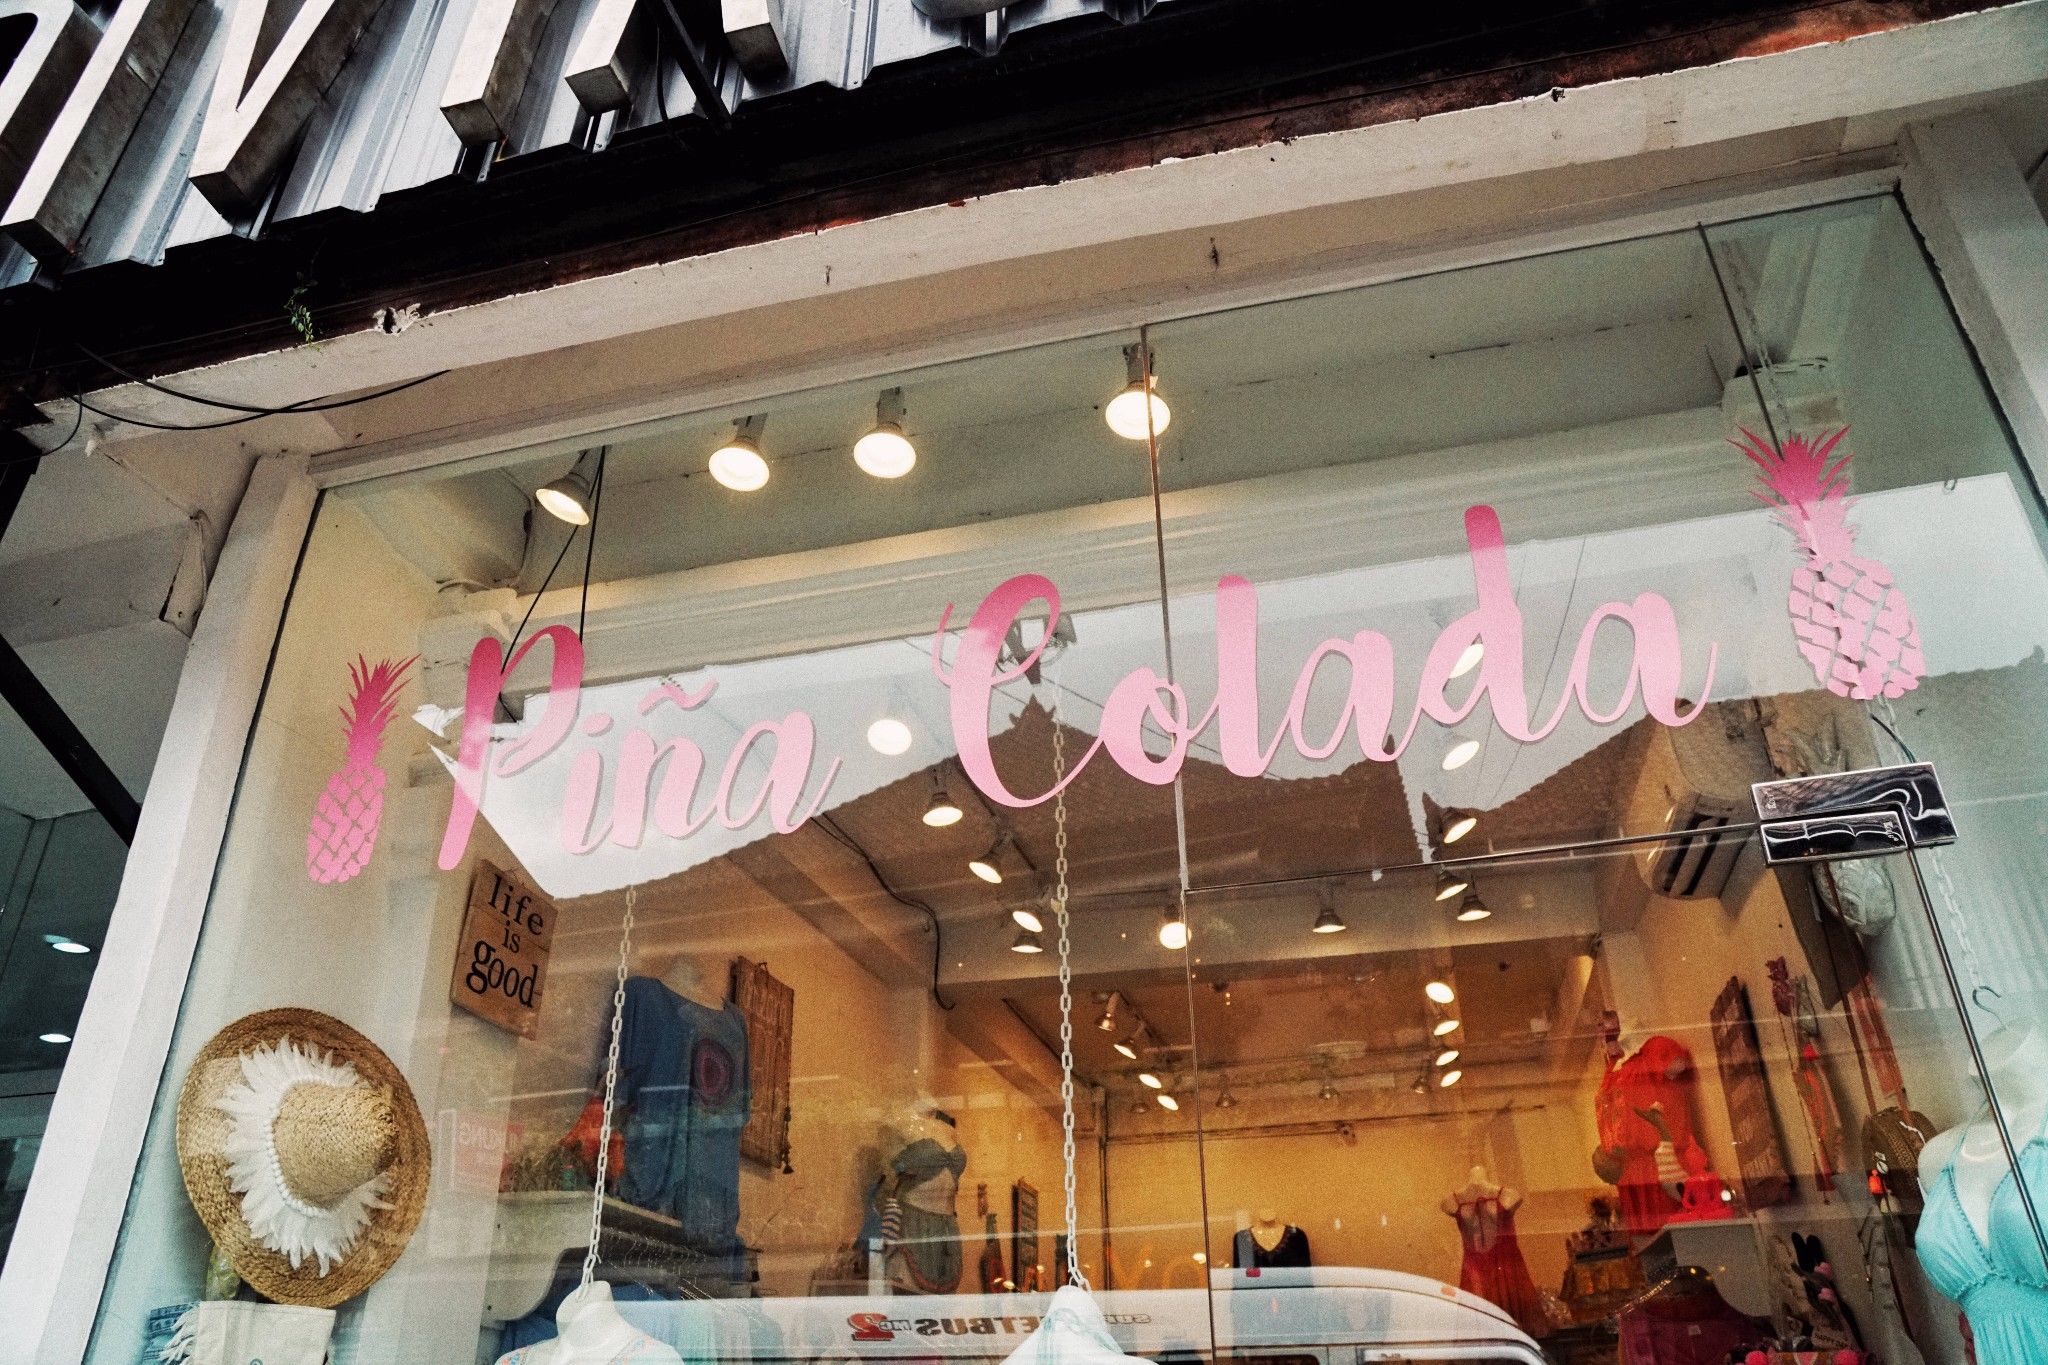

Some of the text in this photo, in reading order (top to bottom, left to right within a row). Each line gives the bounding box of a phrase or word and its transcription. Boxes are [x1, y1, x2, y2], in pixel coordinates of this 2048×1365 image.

[437, 504, 1718, 871] Piña Colada
[488, 873, 544, 936] life
[501, 920, 520, 954] is
[465, 940, 538, 1008] good
